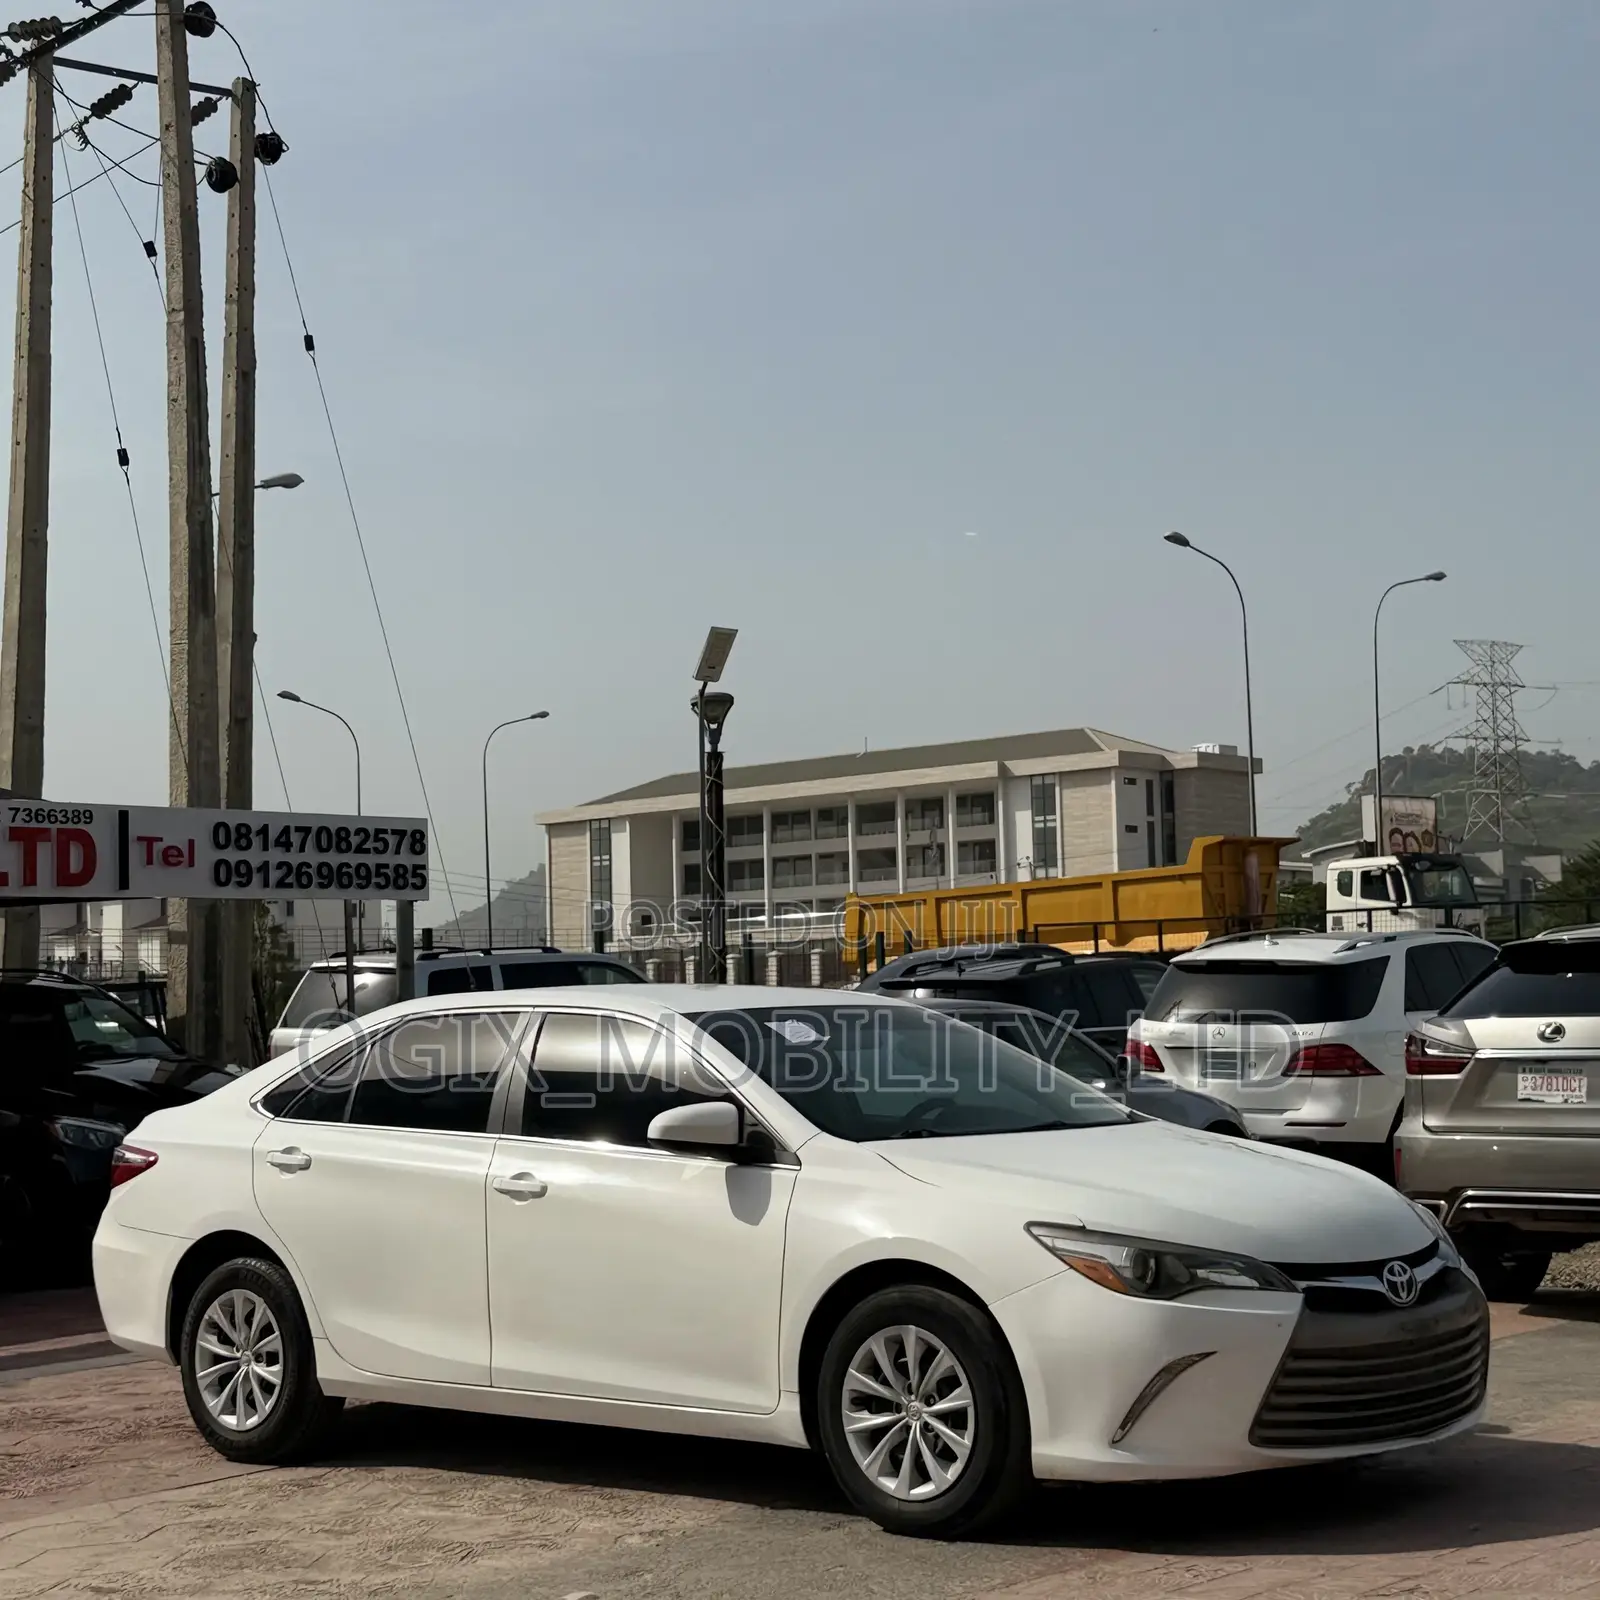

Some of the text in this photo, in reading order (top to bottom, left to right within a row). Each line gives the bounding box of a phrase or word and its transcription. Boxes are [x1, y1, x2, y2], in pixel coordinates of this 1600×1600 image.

[8, 807, 93, 824] 7366389
[137, 835, 195, 868] Tel
[212, 821, 426, 856] 08147082578
[0, 826, 97, 887] TD
[213, 858, 427, 891] 09126969585
